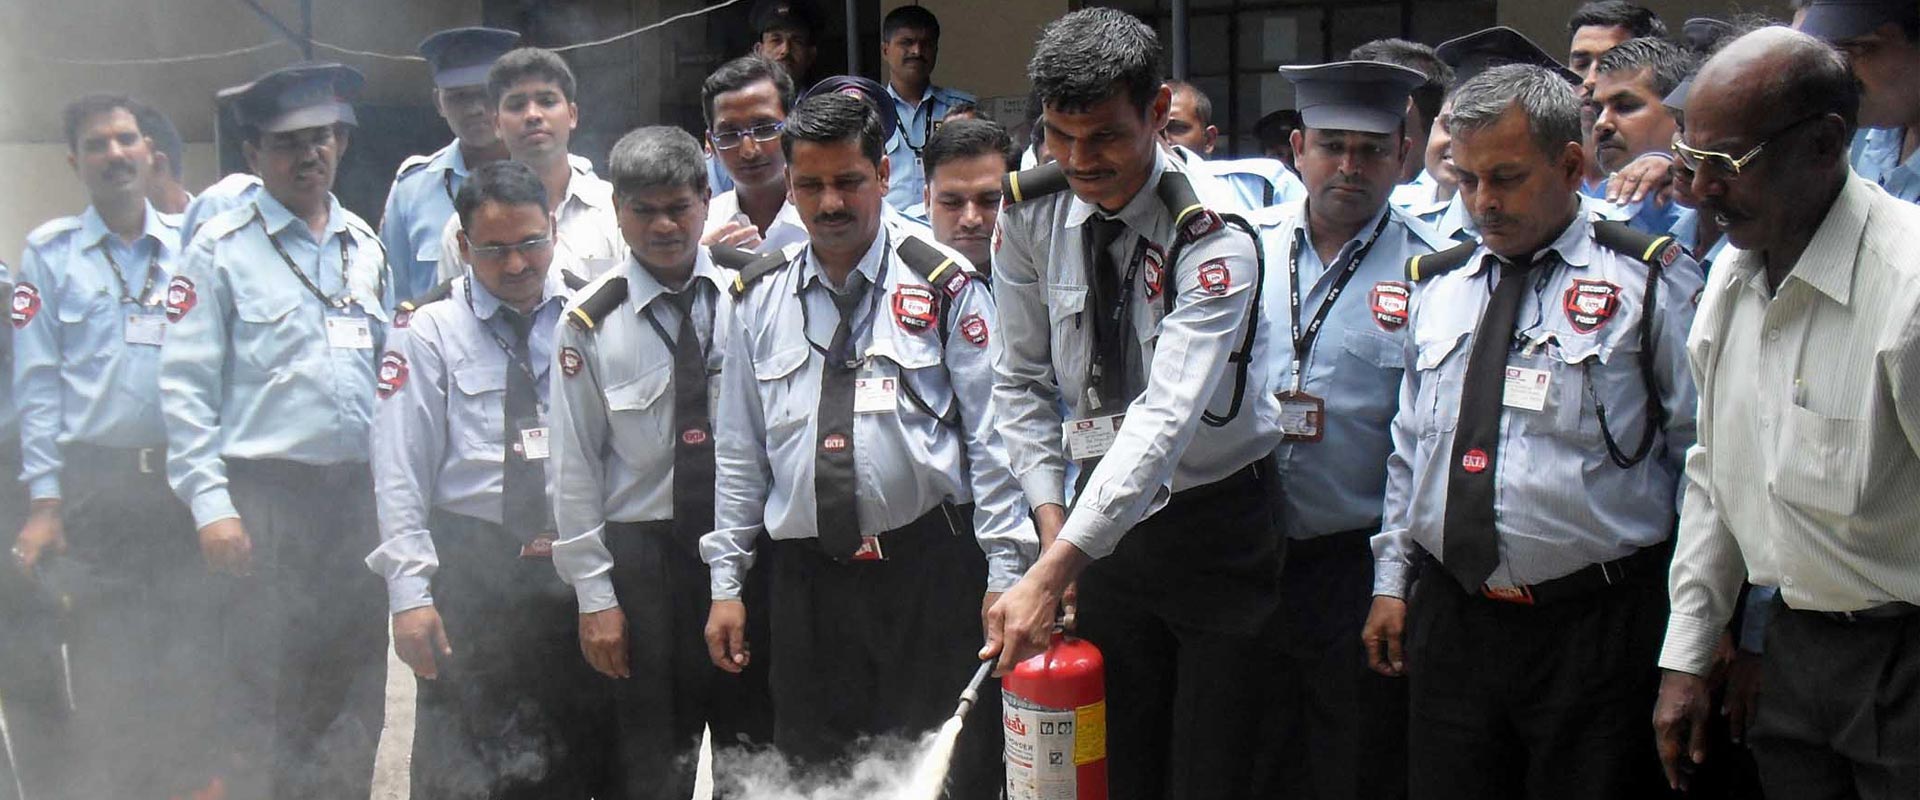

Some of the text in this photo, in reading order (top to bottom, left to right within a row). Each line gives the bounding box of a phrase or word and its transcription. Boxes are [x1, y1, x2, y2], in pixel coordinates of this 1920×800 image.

[900, 287, 934, 301] SECURITY
[1376, 285, 1409, 297] SECURITY
[1578, 285, 1613, 295] SECURITY
[901, 315, 927, 327] FORCE
[1377, 312, 1402, 324] FORCE
[1576, 315, 1597, 324] FORCE
[1462, 454, 1486, 469] EKTA
